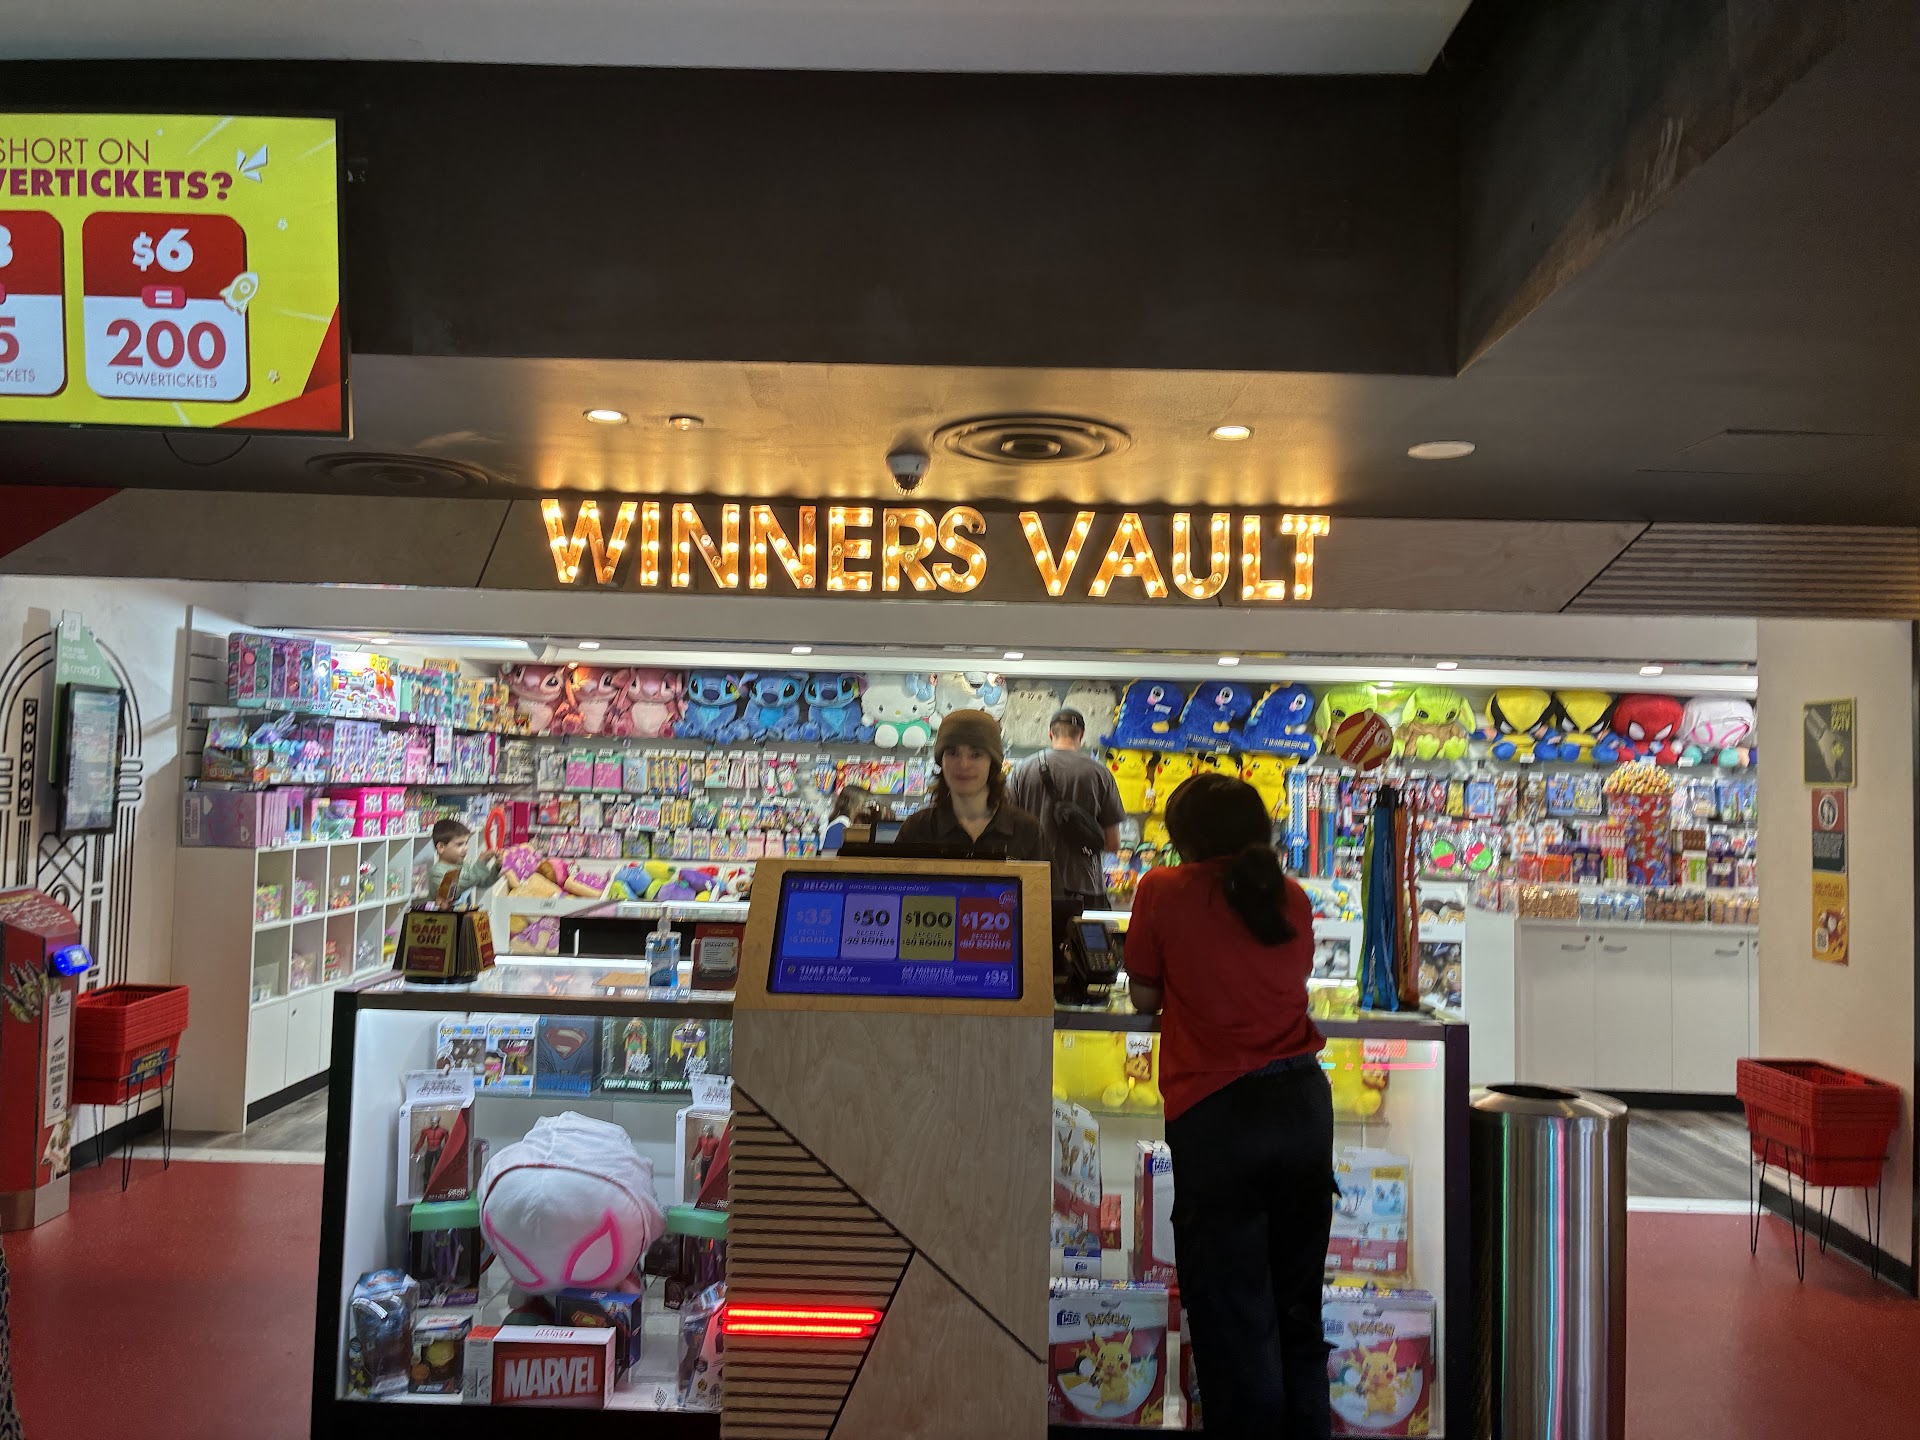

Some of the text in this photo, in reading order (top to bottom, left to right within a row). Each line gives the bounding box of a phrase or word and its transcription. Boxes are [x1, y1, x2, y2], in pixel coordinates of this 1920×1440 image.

[98, 138, 149, 165] ON
[131, 228, 194, 272] $6
[106, 319, 226, 370] 200
[116, 371, 217, 389] POWERTICKETS
[541, 499, 1331, 600] WINNERS VAULT
[796, 908, 832, 924] $35
[853, 910, 890, 926] $50
[905, 911, 953, 928] $100
[962, 911, 1010, 929] $120
[411, 923, 449, 935] GAME
[800, 936, 834, 944] BONUS
[1049, 1277, 1099, 1290] MEGA
[504, 1356, 599, 1398] MARVEL
